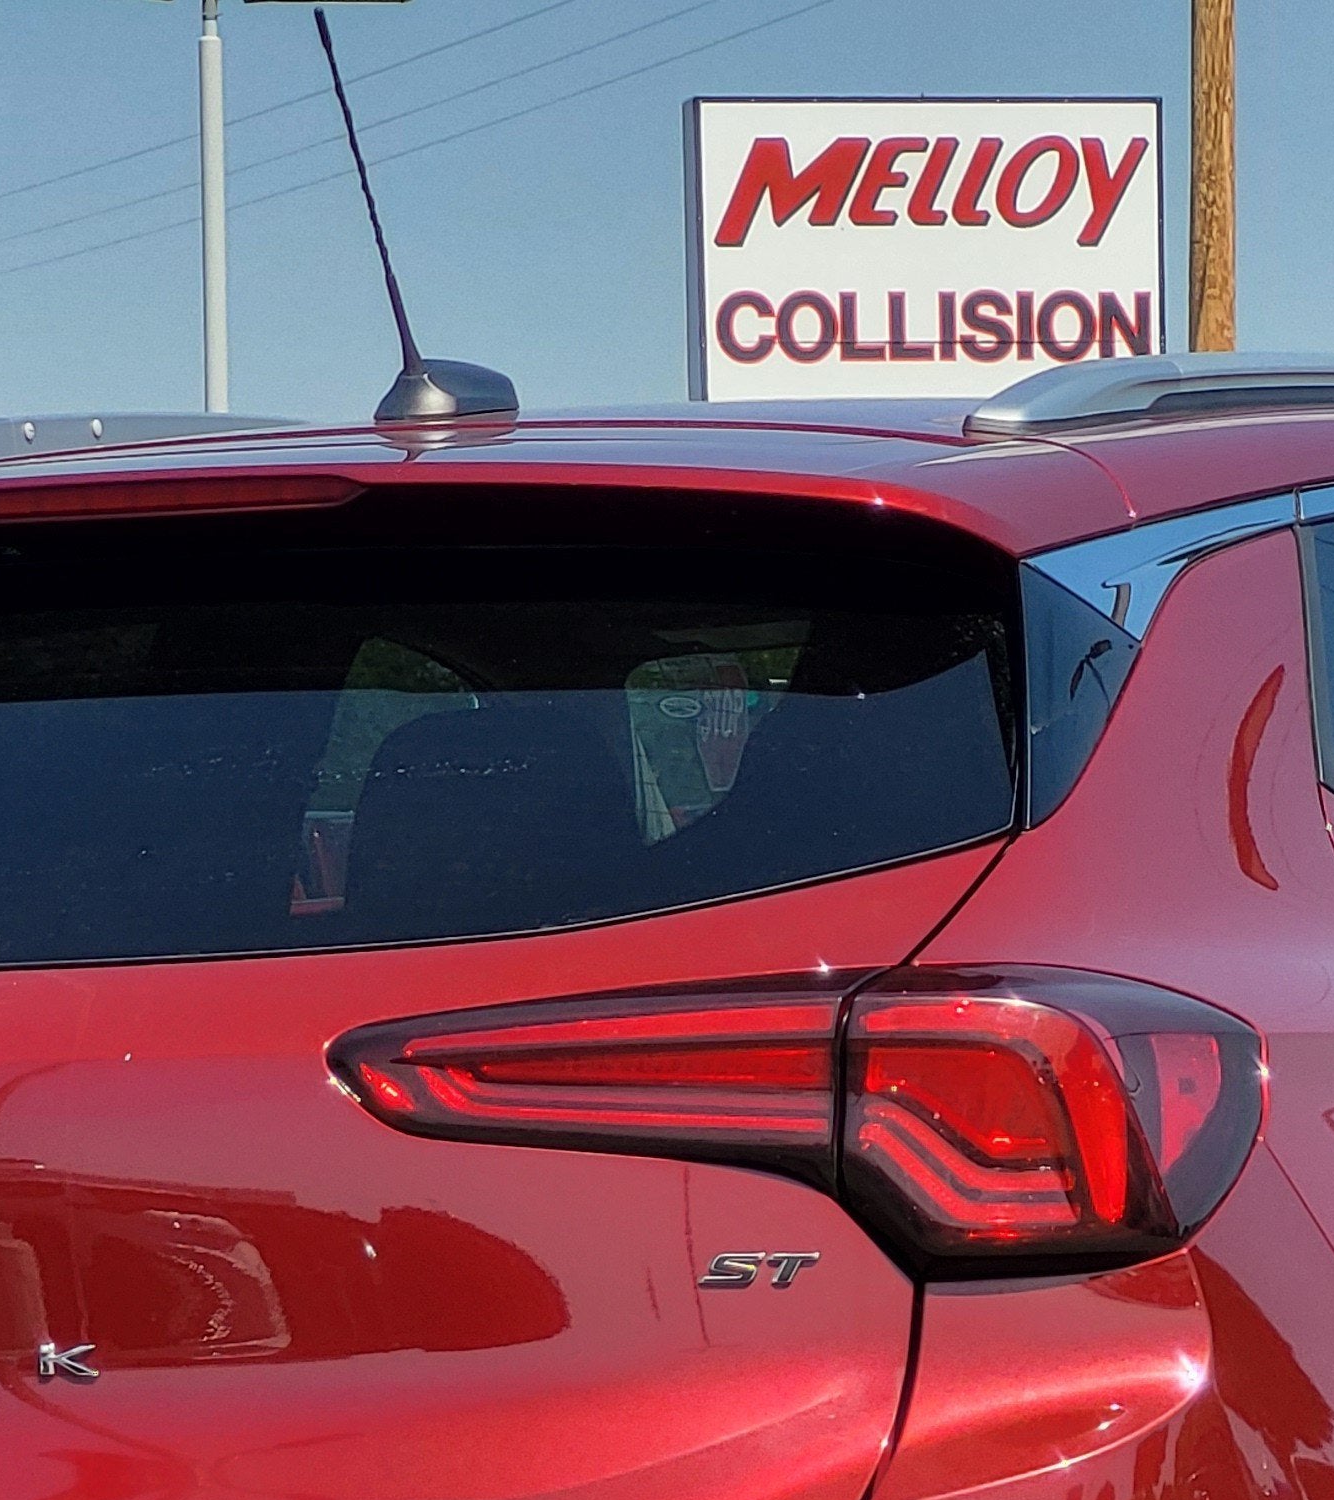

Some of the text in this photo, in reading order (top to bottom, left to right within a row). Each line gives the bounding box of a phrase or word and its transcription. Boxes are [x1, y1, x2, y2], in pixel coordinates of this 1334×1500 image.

[714, 136, 1149, 247] MELLOY
[715, 290, 1153, 363] COLLISION
[698, 1251, 821, 1289] ST
